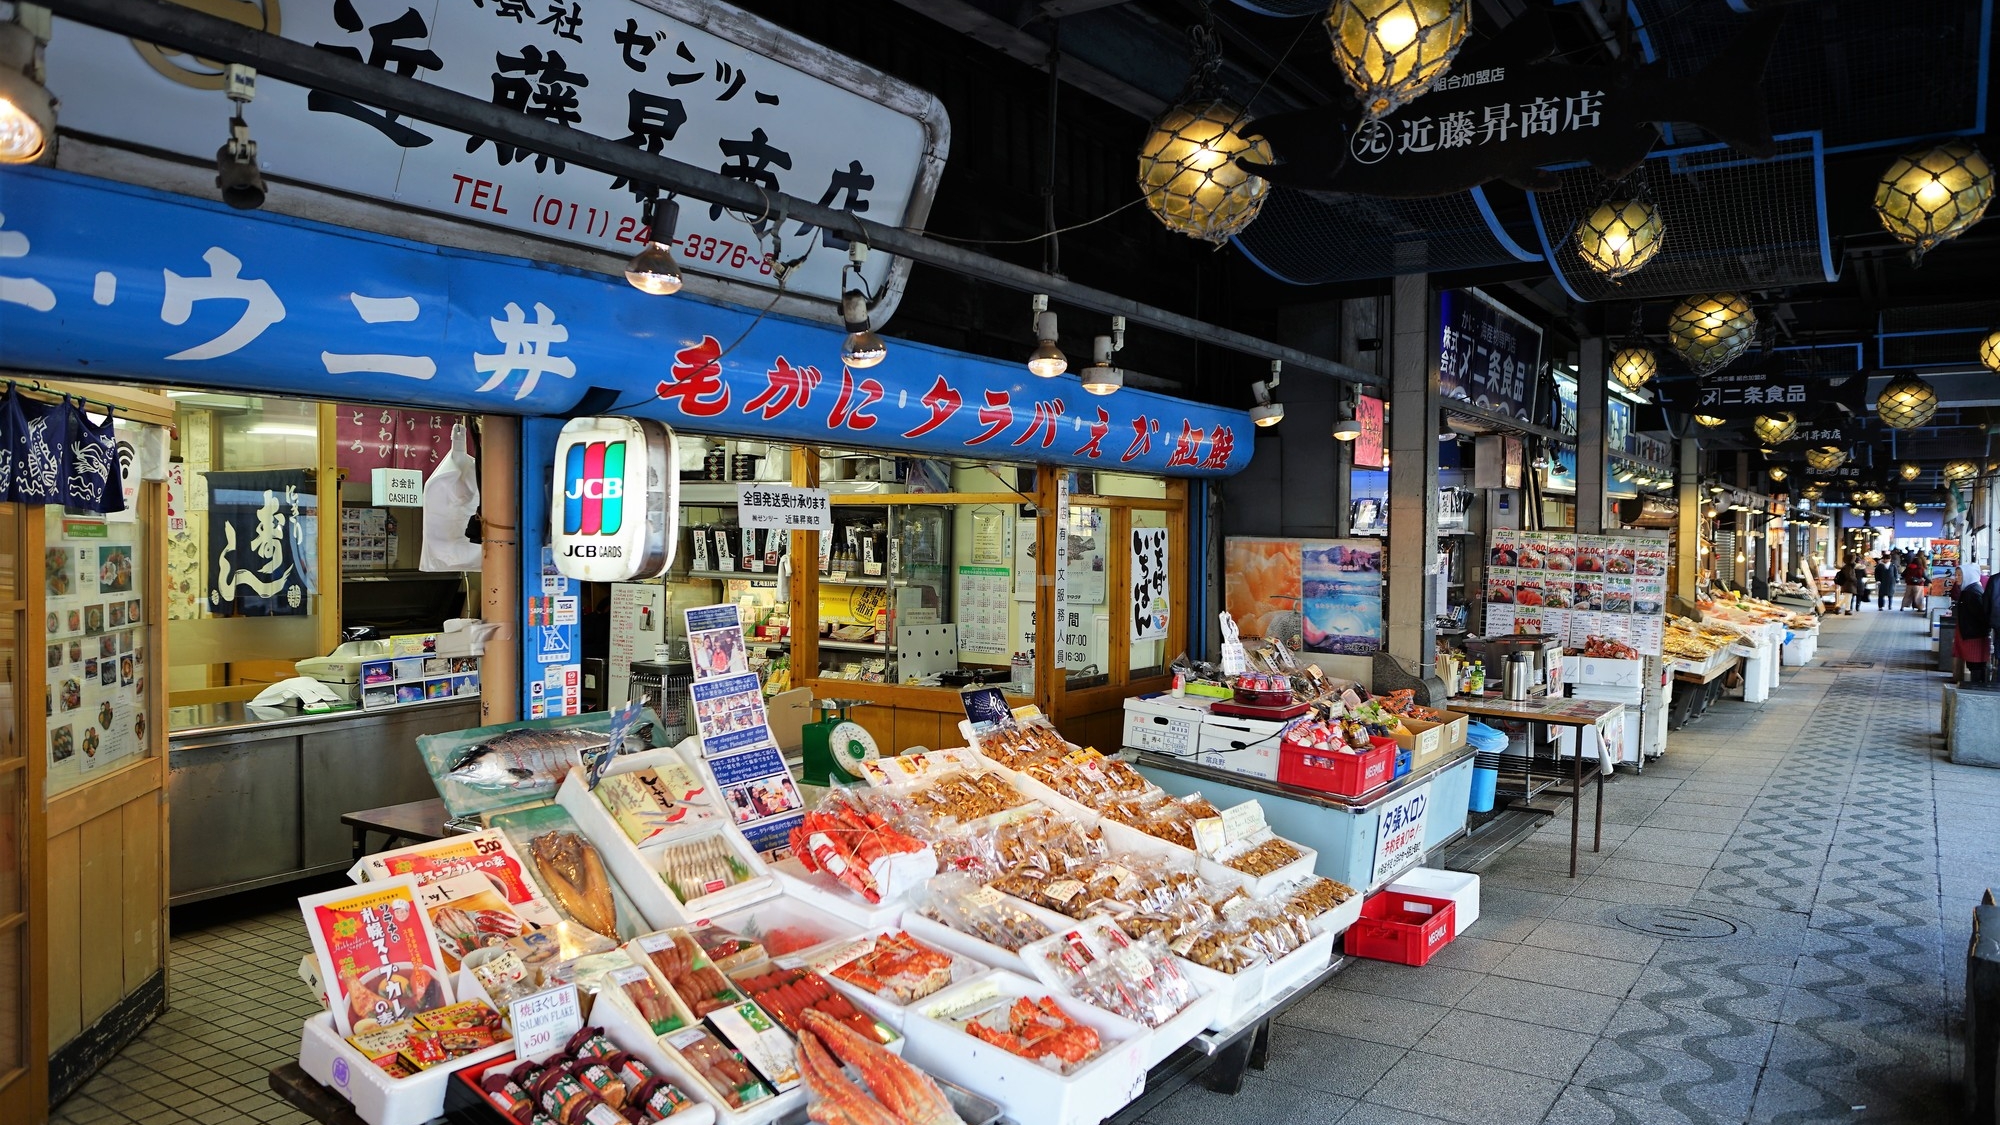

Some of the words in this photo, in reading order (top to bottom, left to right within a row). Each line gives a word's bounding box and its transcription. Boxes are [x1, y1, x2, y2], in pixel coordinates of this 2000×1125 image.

[474, 0, 583, 43] 会社
[614, 18, 780, 106] ゼンツー
[308, 8, 876, 250] 近藤昇商店
[1398, 90, 1605, 155] 近藤昇商店
[452, 174, 508, 216] TEL
[1473, 345, 1526, 403] 二条食品
[1723, 384, 1806, 404] 二条食品
[351, 410, 364, 454] とろ
[379, 409, 393, 459] あわび
[403, 418, 417, 458] うに
[429, 415, 442, 463] ほっき
[389, 493, 418, 503] CASHIER
[391, 478, 415, 489] お会計
[565, 478, 623, 499] JCB
[785, 514, 820, 525] 近藤昇商店
[563, 545, 597, 558] JCB
[599, 546, 622, 557] CARDS
[1056, 486, 1067, 664] 本店有中文服務人員
[1206, 756, 1226, 766] 富良野
[1382, 794, 1427, 839] 夕張メロン
[520, 991, 571, 1017] 焼ほぐし鮭
[520, 1014, 549, 1032] SALMON
[551, 1005, 575, 1022] FLAKE
[524, 1030, 551, 1049] ¥500
